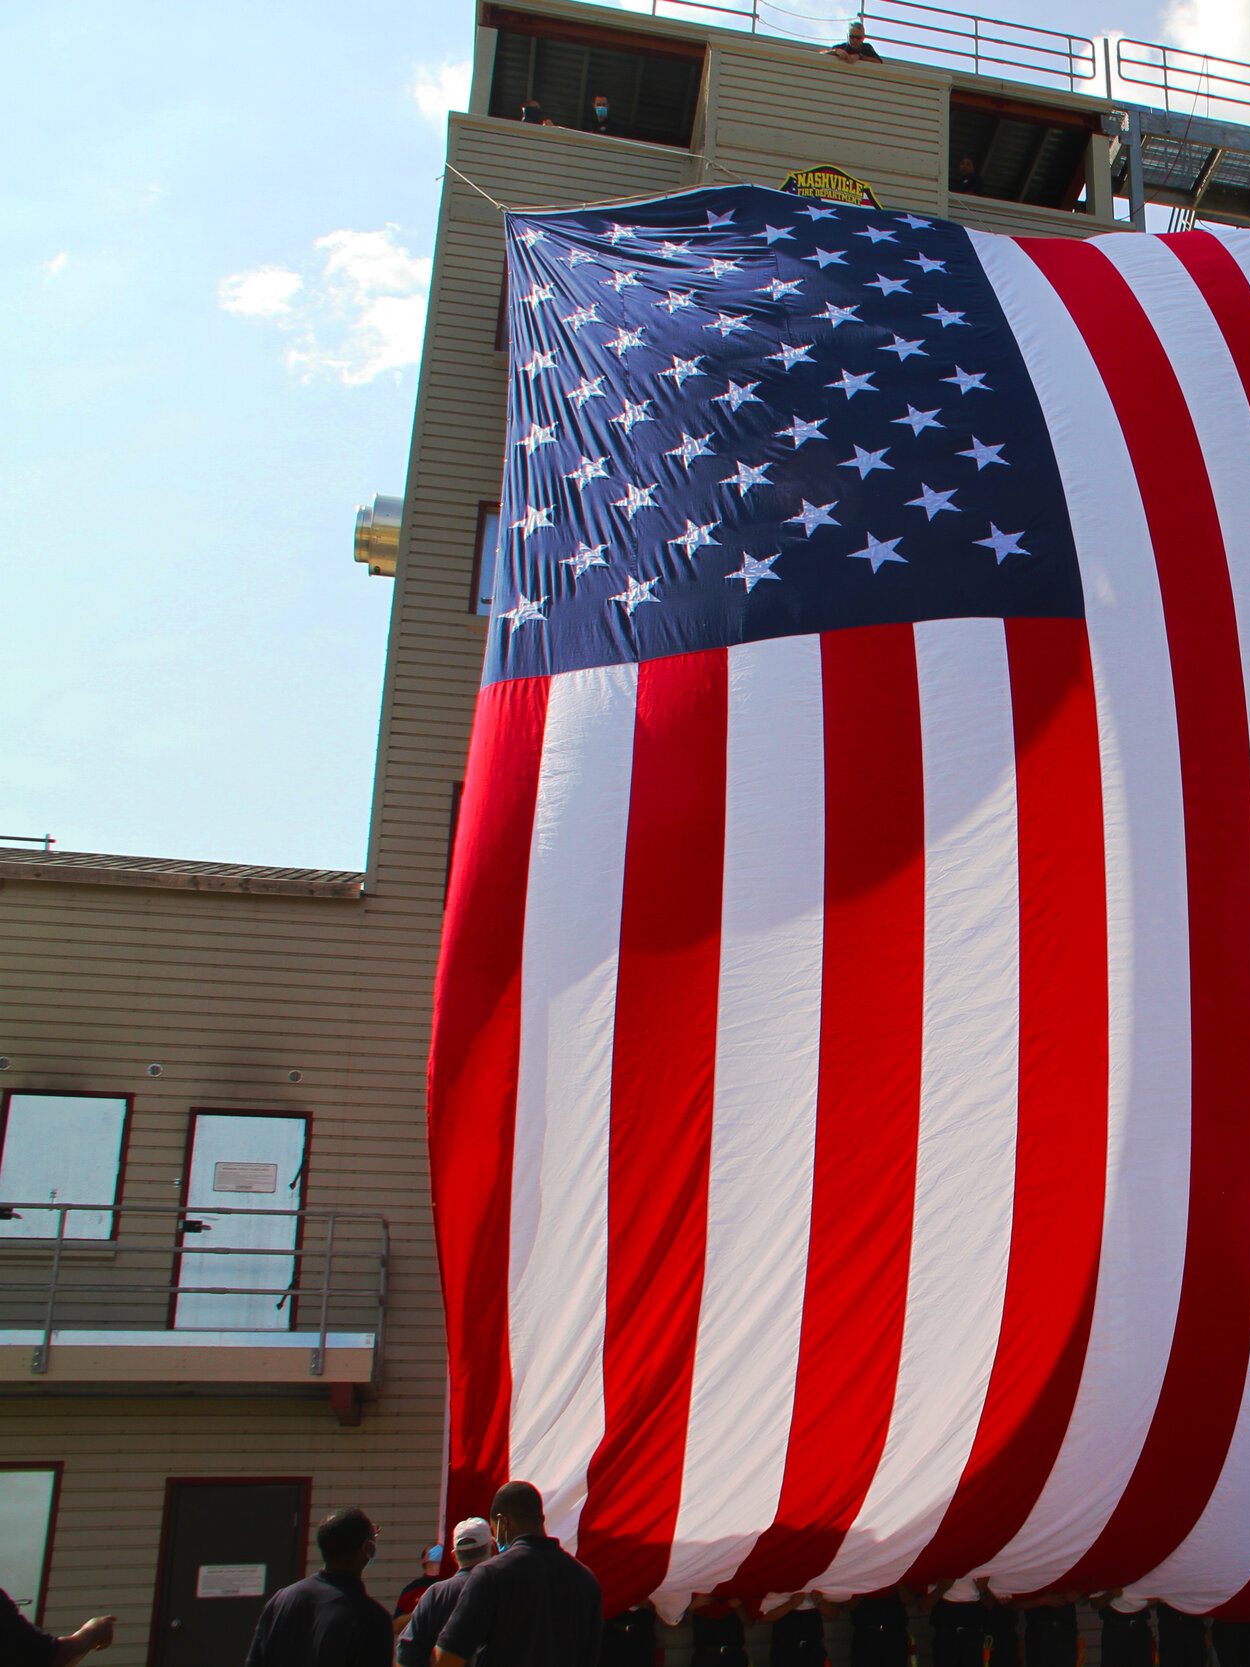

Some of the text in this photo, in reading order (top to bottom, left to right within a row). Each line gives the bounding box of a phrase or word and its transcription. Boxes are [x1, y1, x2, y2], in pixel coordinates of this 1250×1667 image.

[797, 172, 863, 196] NASHVILLE
[798, 188, 862, 205] FIRE DEPARTMENT
